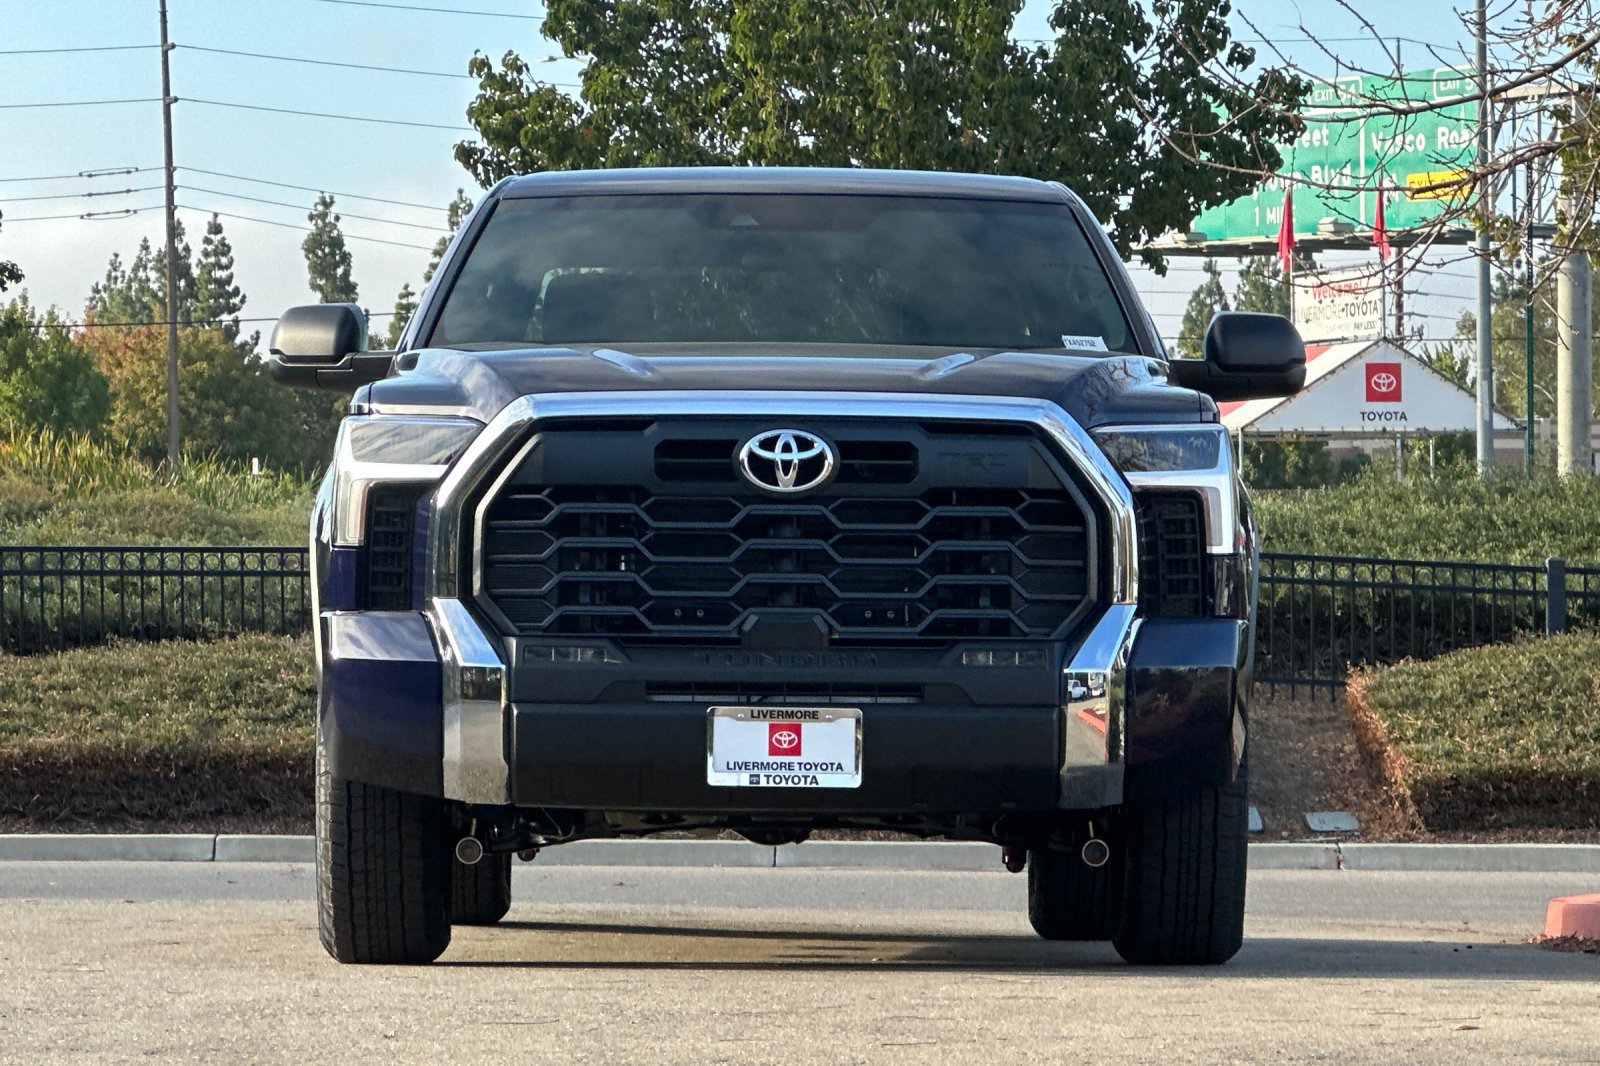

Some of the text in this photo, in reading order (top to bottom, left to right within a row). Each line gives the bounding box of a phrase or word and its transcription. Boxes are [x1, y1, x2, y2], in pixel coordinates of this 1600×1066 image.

[1314, 88, 1334, 102] EXIT
[1371, 131, 1426, 153] Vasco
[1311, 163, 1351, 187] Blvd
[1254, 206, 1260, 227] 1
[1344, 300, 1379, 318] TOYOTA
[1360, 411, 1408, 421] TOYOTA
[750, 709, 819, 720] LIVERMORE
[726, 761, 844, 772] LIVERMORE TOYOTA
[763, 774, 819, 786] TOYOTA
